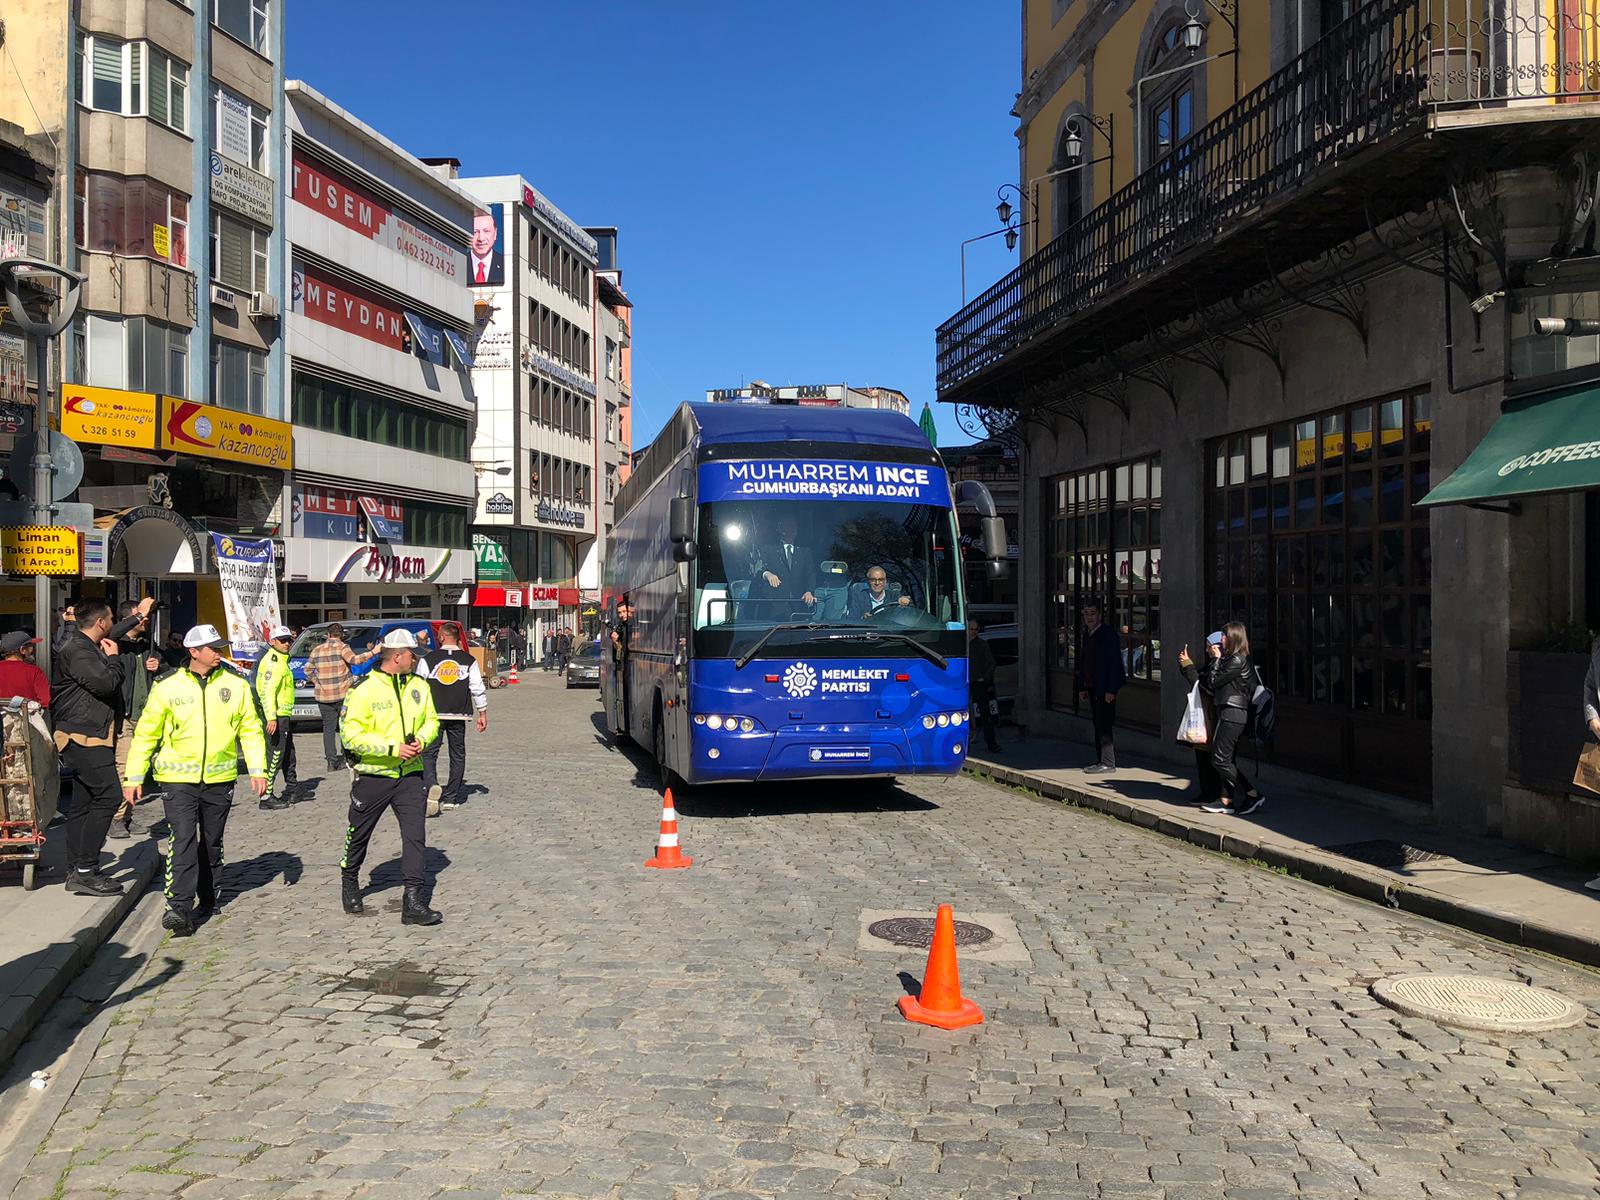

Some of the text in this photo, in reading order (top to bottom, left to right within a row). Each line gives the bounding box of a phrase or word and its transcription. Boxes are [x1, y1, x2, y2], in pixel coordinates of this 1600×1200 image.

[225, 184, 267, 210] KOMPANZASYON
[230, 196, 246, 209] PROJE
[404, 241, 418, 259] 462
[420, 248, 434, 266] 322
[436, 256, 444, 271] 24
[446, 262, 455, 276] 25
[307, 282, 400, 337] MEYDAN
[91, 426, 136, 438] 326 51 59
[255, 429, 287, 442] kömürleri
[219, 435, 288, 465] kazancıoğlu
[728, 464, 869, 481] MUHARREM
[742, 482, 920, 498] CUMHURBAŞKANI ADAYI
[17, 532, 60, 542] Liman
[37, 545, 75, 556] Durağı
[366, 546, 426, 582] Aypam
[510, 595, 518, 604] E
[533, 587, 558, 601] ECZANE
[822, 669, 889, 680] MEMLEKET
[821, 682, 870, 693] PARTİSİ
